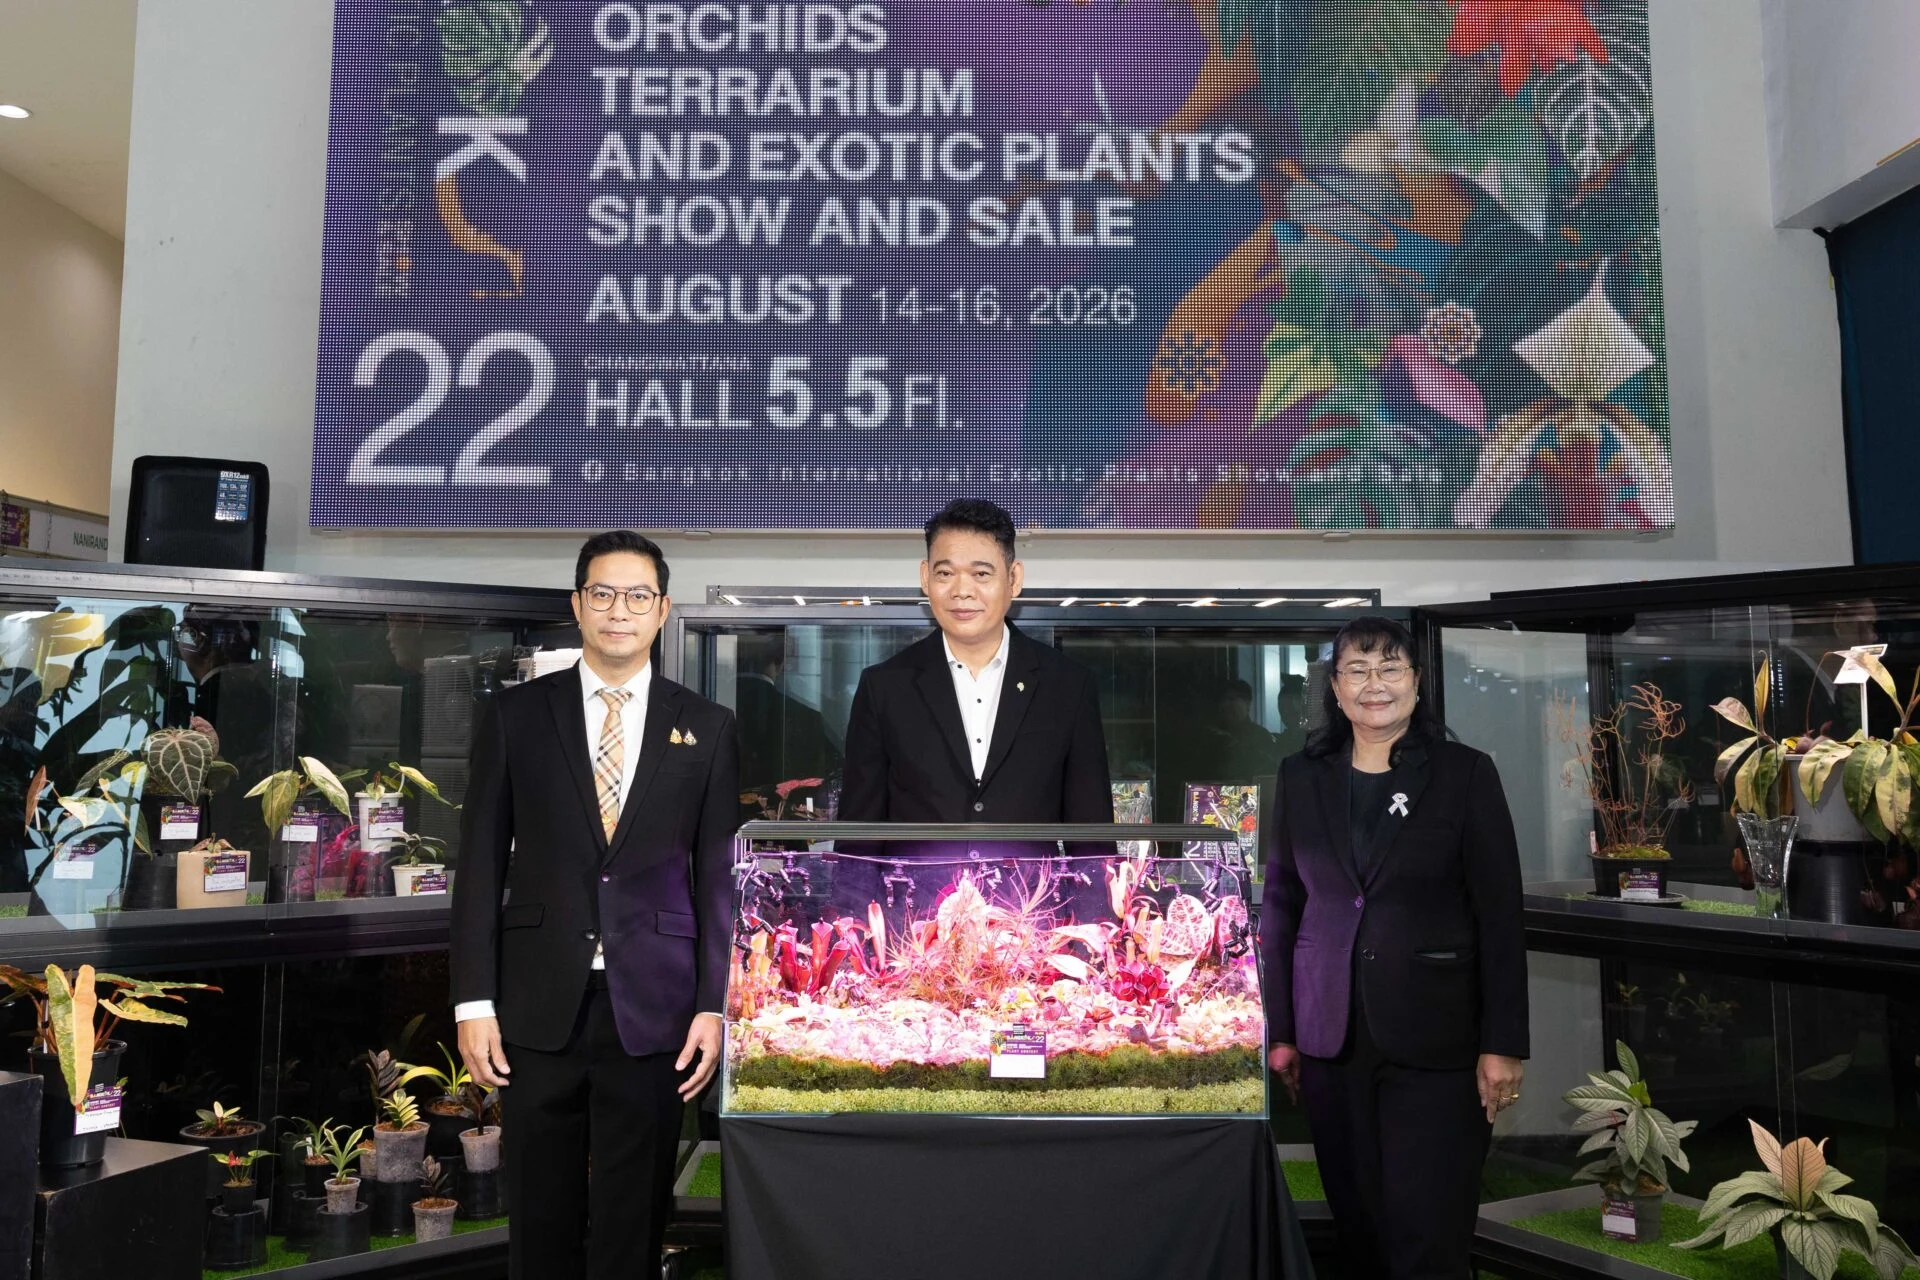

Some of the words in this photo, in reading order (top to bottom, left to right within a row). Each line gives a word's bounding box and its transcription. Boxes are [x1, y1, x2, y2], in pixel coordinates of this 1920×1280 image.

[593, 3, 889, 53] ORCHIDS
[591, 67, 974, 118] TERRARIUM
[589, 131, 731, 181] AND
[748, 131, 984, 181] EXOTIC
[1002, 131, 1257, 183] PLANTS
[586, 196, 792, 246] SHOW
[809, 197, 950, 246] AND
[967, 197, 1135, 247] SALE
[585, 273, 853, 325] AUGUST
[1029, 285, 1138, 326] 2026
[345, 330, 556, 484] 22
[585, 379, 752, 428] HALL
[765, 356, 892, 430] 5.5
[624, 463, 751, 487] Bangkok
[989, 463, 1086, 482] Exotic
[1218, 464, 1293, 483] Show
